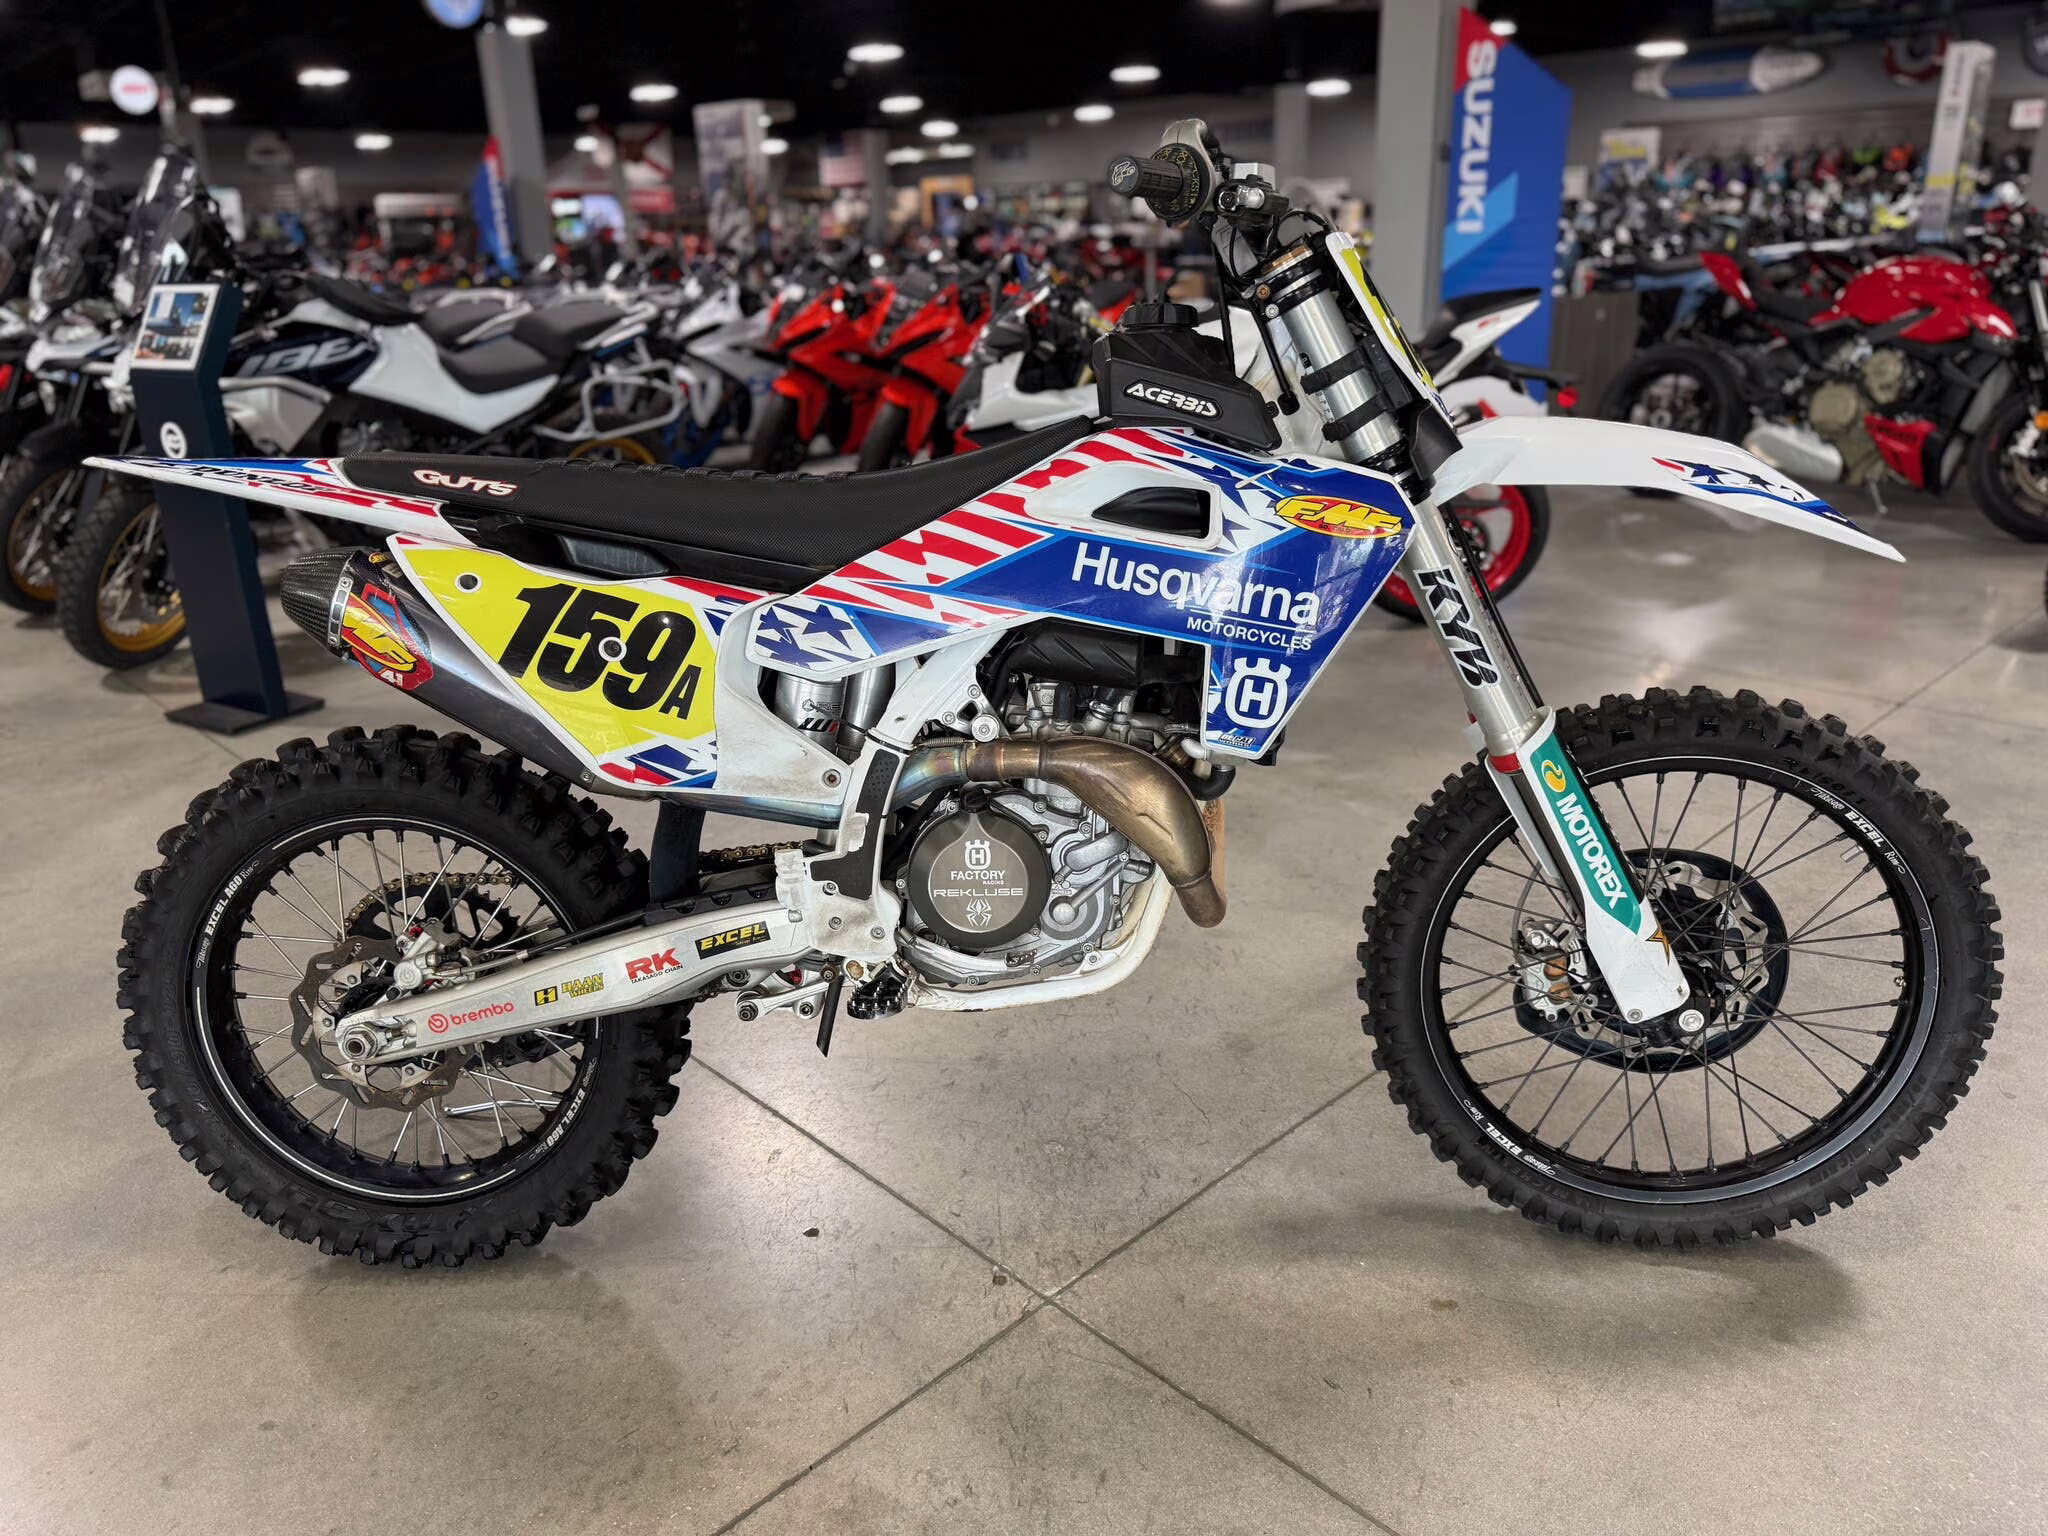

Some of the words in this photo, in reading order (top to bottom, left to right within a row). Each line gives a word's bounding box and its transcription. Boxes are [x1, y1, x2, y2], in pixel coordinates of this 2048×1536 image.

[1455, 39, 1498, 235] SUZUKI
[413, 469, 518, 496] GUTS
[1275, 498, 1403, 533] FMF
[1071, 541, 1321, 626] Husqvarna
[1186, 617, 1312, 651] MOTORCYCLES
[1412, 565, 1501, 689] KYB
[1845, 811, 1885, 848] EXCEL
[1556, 792, 1629, 910] MOTOREX
[933, 887, 1024, 898] REKLUSE
[950, 870, 1006, 881] FACTORY
[204, 899, 229, 936] EXCEL
[701, 923, 765, 951] EXCEL
[625, 947, 682, 980] RK
[631, 972, 664, 984] TAKASAGO
[665, 965, 684, 974] CHAIN
[450, 1001, 515, 1026] brembo
[561, 1088, 586, 1125] EXCEL
[1485, 1122, 1523, 1156] EXCEL
